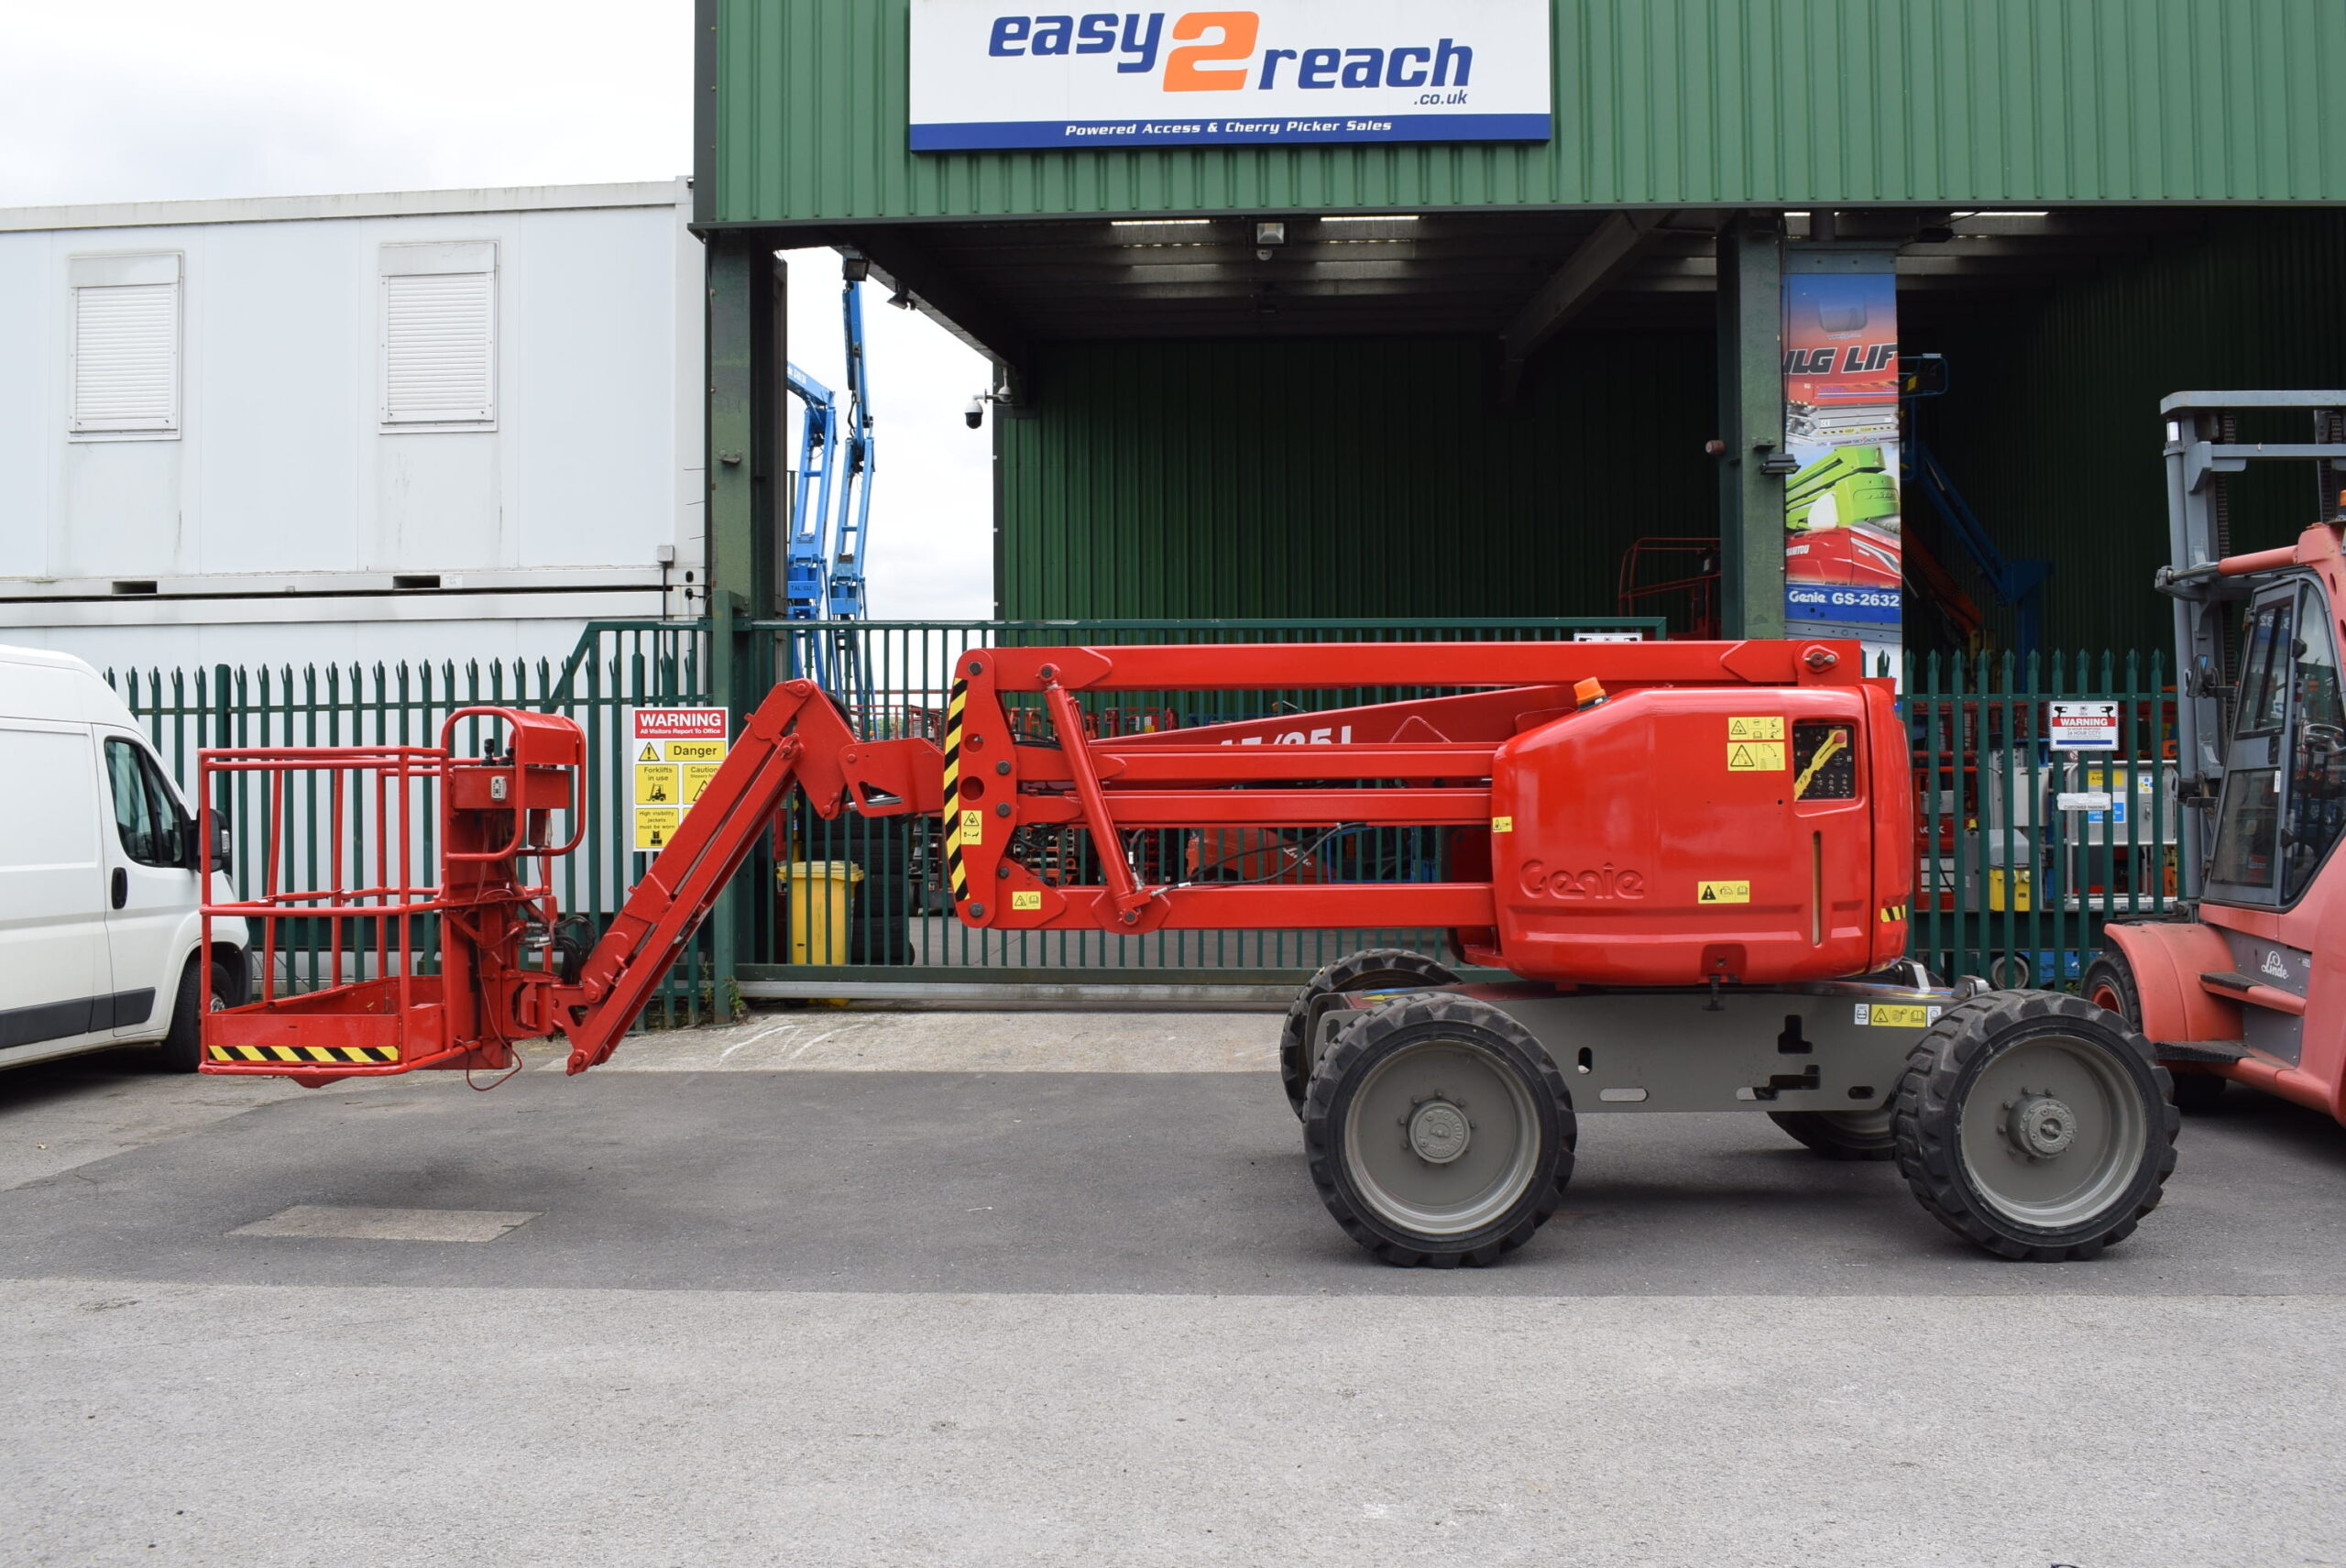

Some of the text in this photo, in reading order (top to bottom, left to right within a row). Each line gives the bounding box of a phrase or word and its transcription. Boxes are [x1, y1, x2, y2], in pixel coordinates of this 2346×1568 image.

[1414, 90, 1468, 105] .co.uk
[1065, 120, 1393, 137] Powered Access & Cherry Picker Sales
[1789, 590, 1900, 607] Genie GS-2632
[640, 713, 721, 727] WARNING
[2060, 718, 2109, 726] WARNING
[674, 745, 718, 758] Danger
[1518, 859, 1645, 900] Genie
[2261, 950, 2289, 980] Linde
